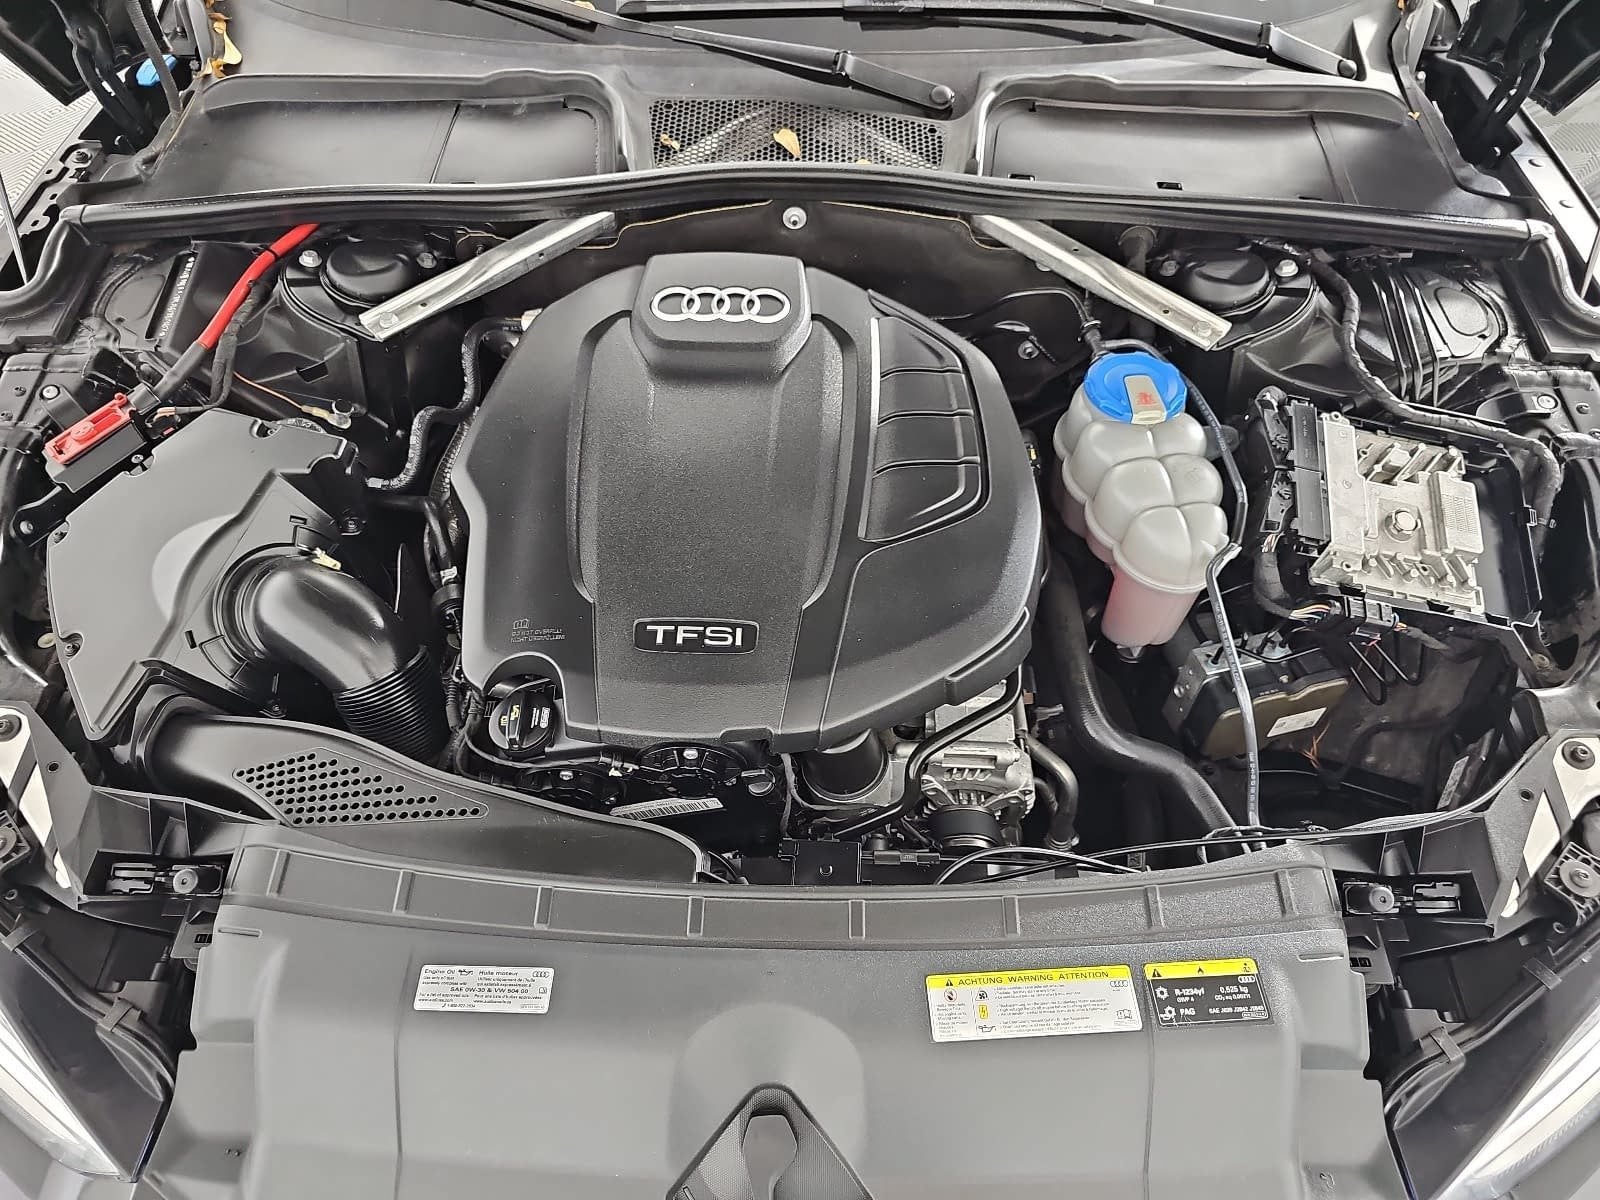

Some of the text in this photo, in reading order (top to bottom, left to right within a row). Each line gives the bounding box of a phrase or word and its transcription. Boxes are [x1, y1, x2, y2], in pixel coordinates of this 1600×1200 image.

[646, 625, 743, 646] TFSI
[958, 971, 1109, 986] ACHTUNG WARNING ATTENTION
[1239, 985, 1249, 994] kg
[1180, 1007, 1196, 1015] PAG
